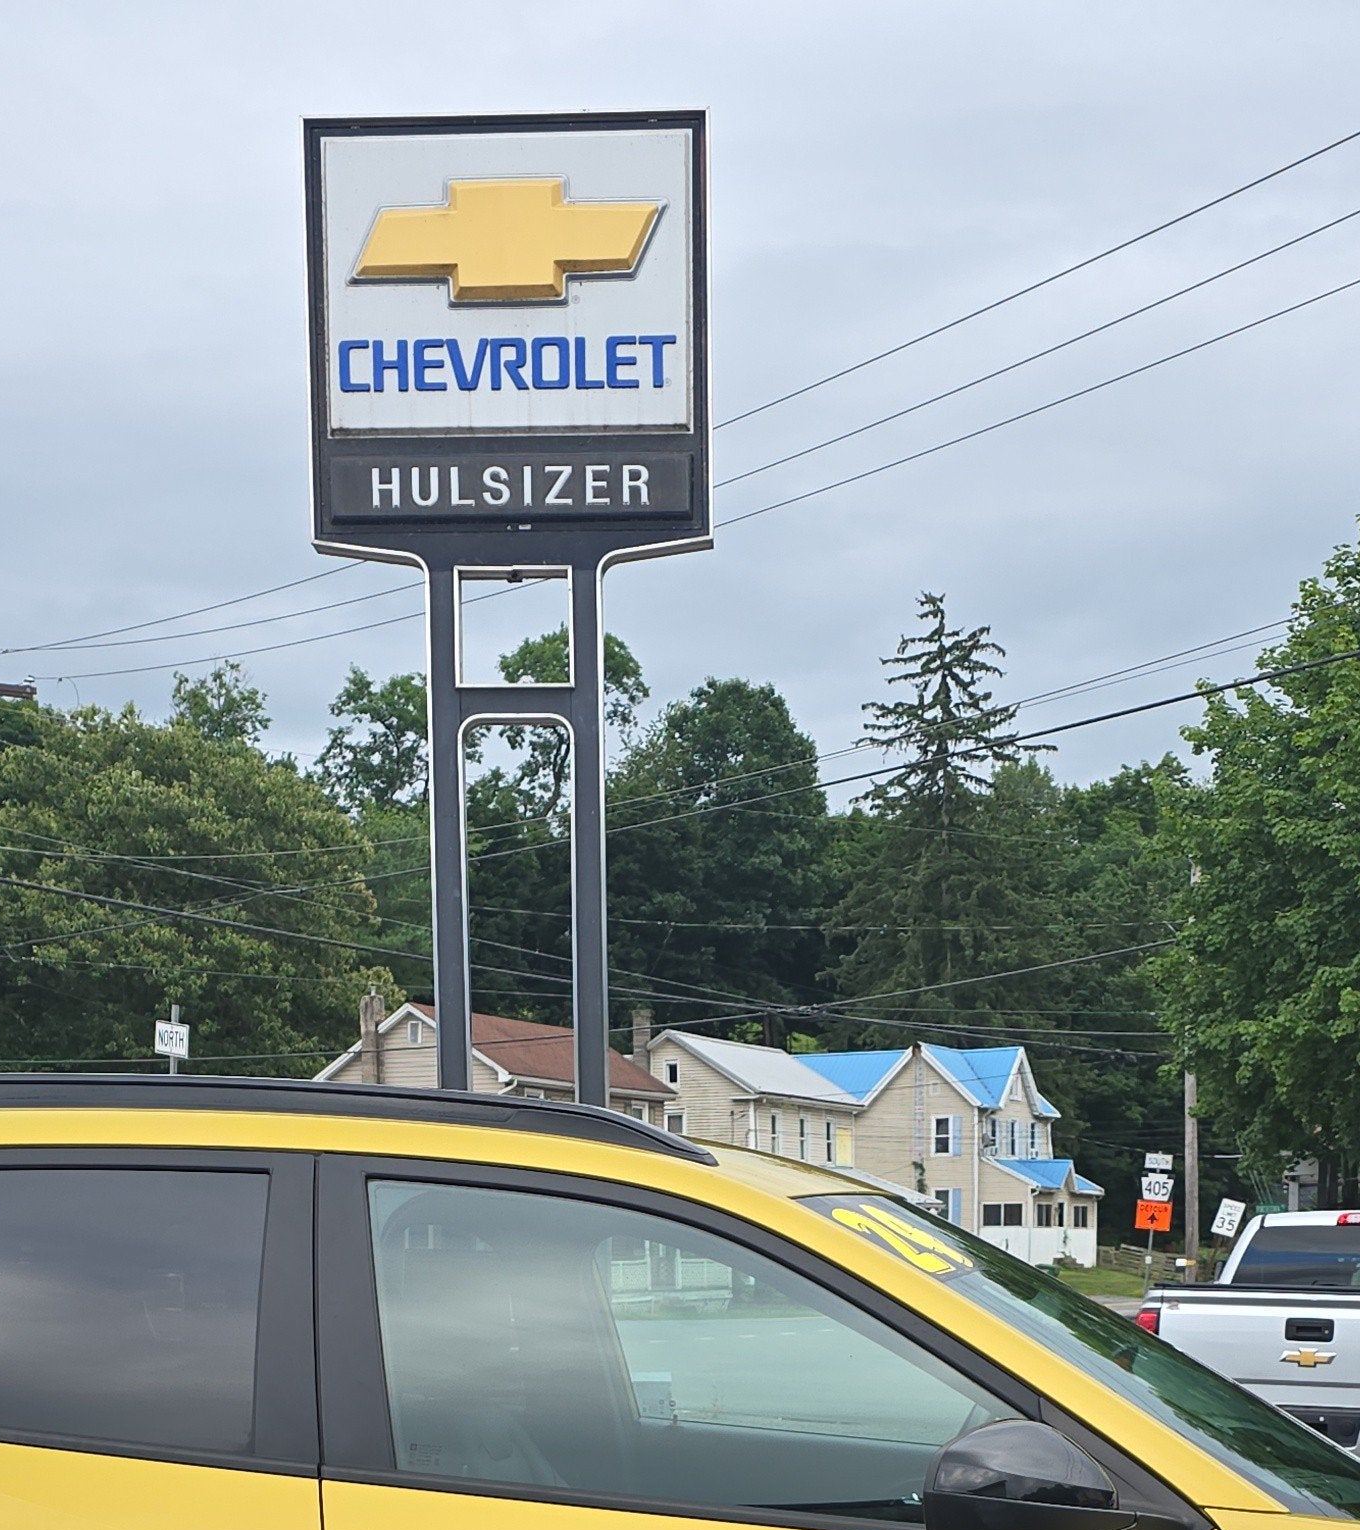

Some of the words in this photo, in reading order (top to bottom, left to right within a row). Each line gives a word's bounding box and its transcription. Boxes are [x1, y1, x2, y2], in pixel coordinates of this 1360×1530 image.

[339, 335, 678, 393] CHEVROLET
[371, 464, 651, 509] HULSIZER
[158, 1029, 184, 1049] NORTH
[1144, 1180, 1169, 1197] 405
[1140, 1204, 1168, 1213] DETOUR
[1216, 1216, 1237, 1232] 35
[831, 1204, 974, 1275] 24
